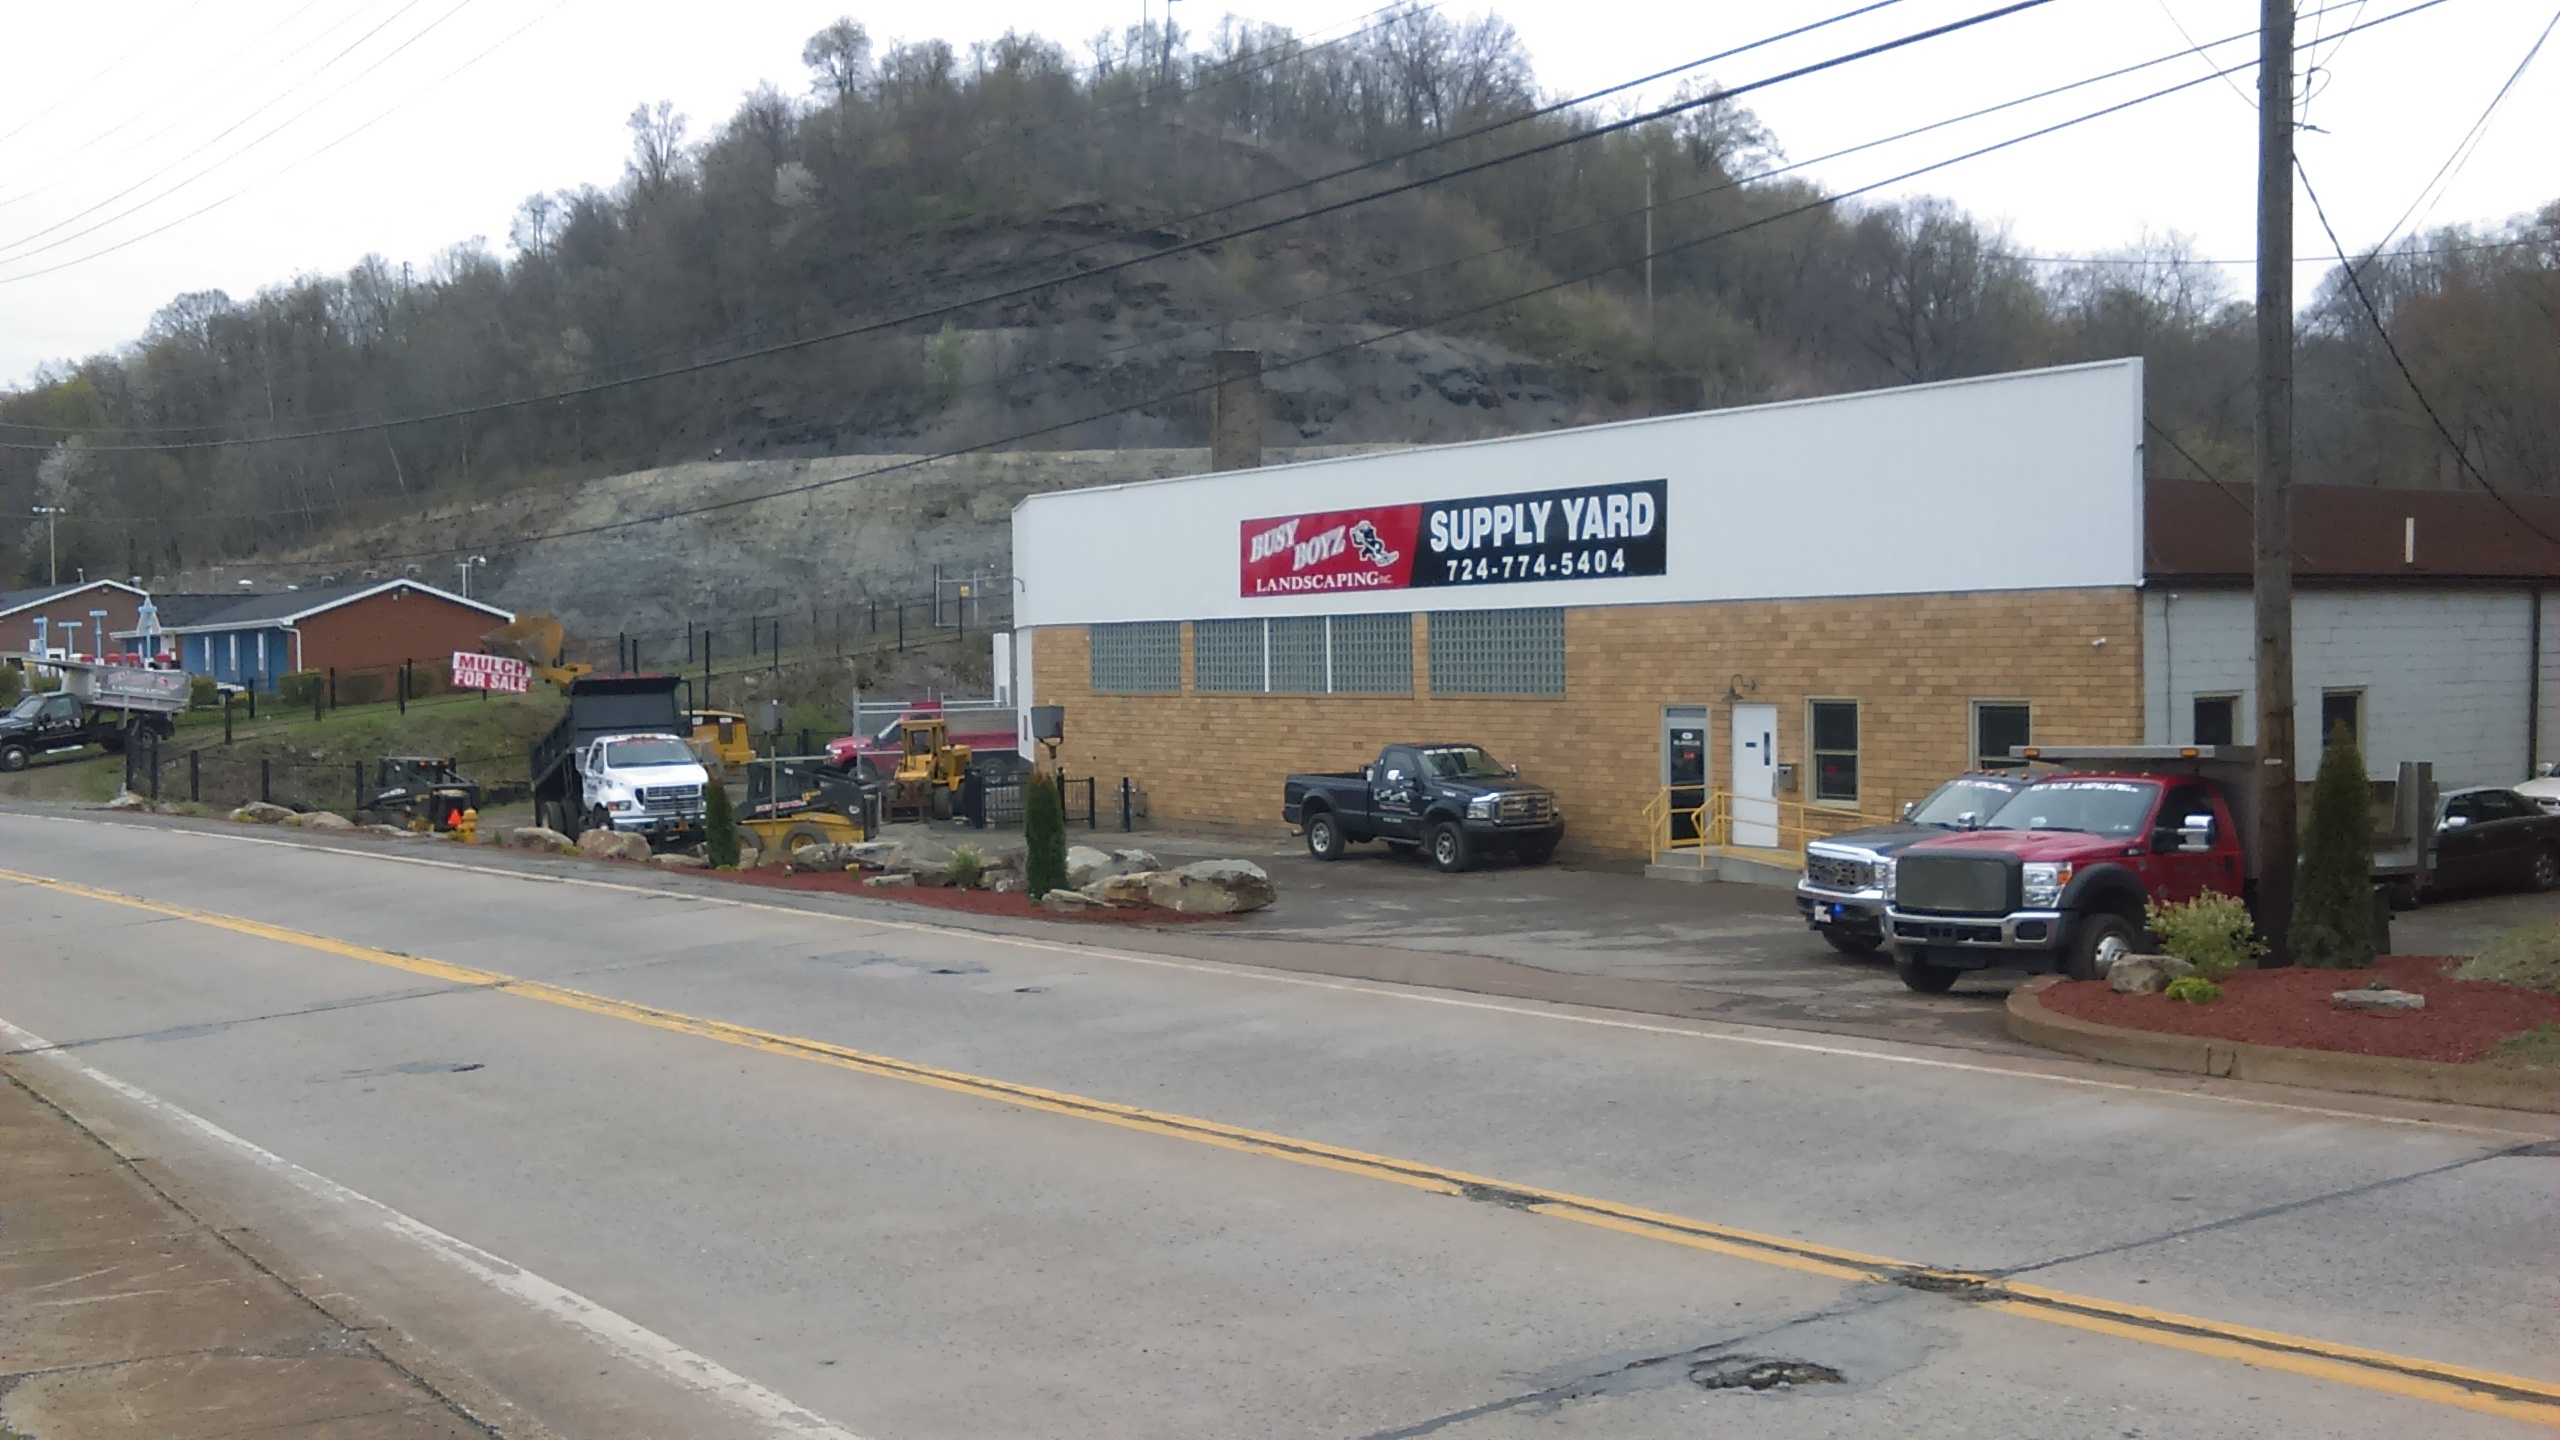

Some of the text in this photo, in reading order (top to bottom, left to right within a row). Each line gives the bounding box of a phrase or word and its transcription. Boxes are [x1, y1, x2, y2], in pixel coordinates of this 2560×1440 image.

[1430, 492, 1655, 552] SUPPLY YARD
[1250, 518, 1300, 563] BUSY
[1292, 525, 1347, 571] BOYZ
[1446, 548, 1625, 581] 724-774-5404
[1256, 571, 1379, 592] LANDSCAPING
[454, 670, 527, 692] FOR SALE
[459, 655, 527, 675] MULCH
